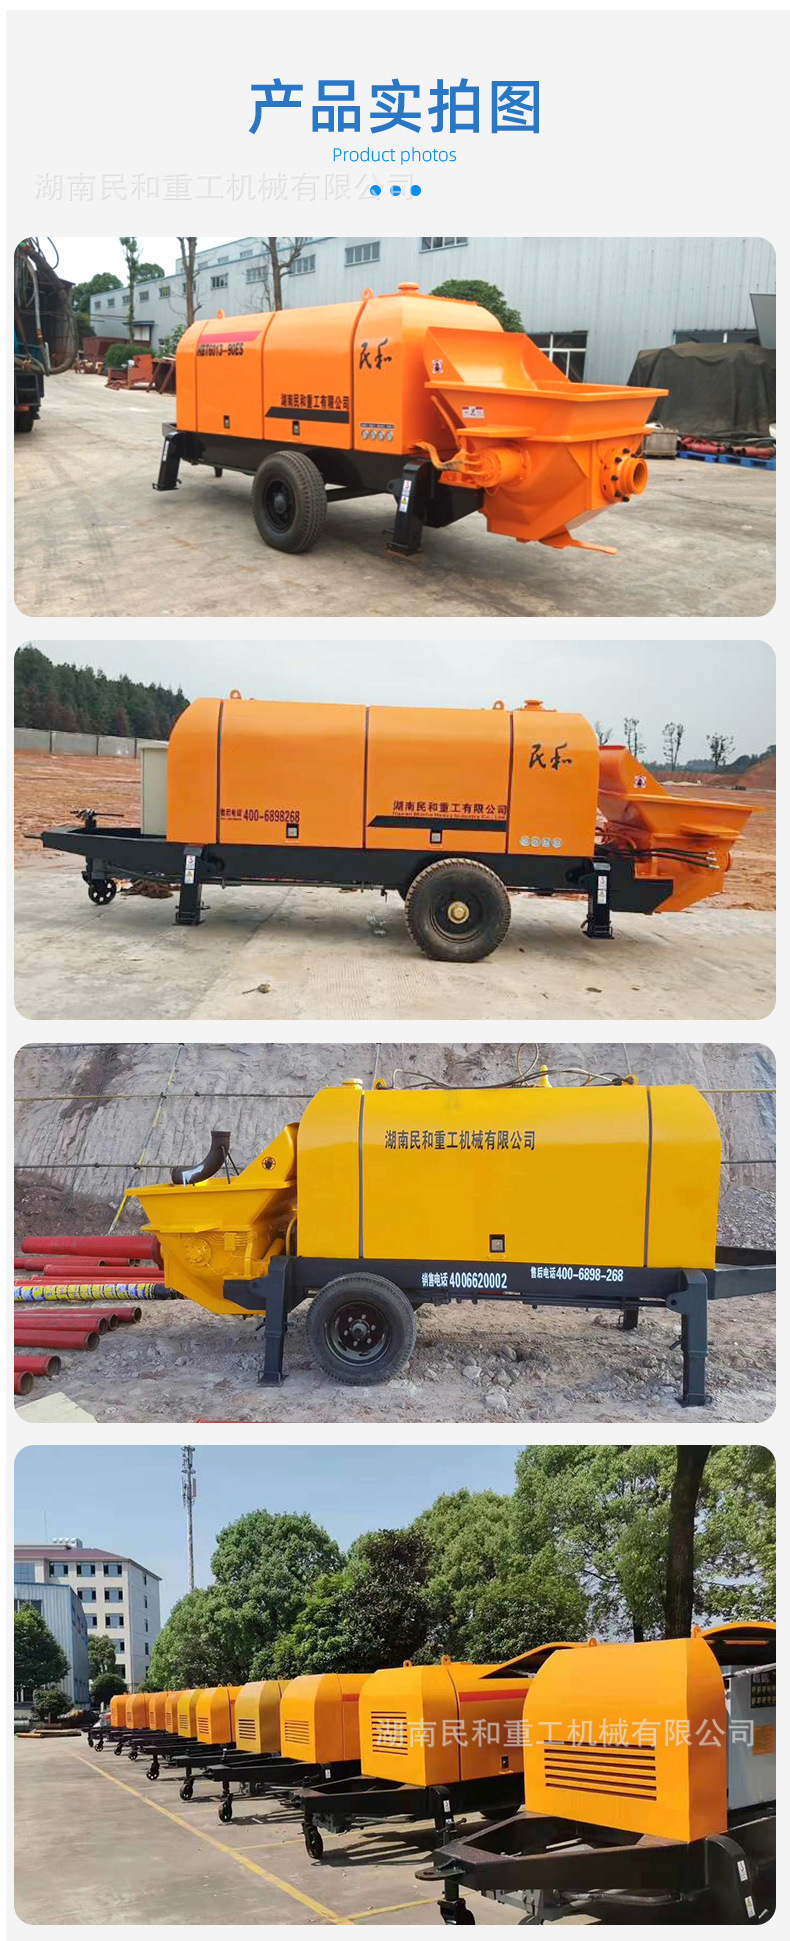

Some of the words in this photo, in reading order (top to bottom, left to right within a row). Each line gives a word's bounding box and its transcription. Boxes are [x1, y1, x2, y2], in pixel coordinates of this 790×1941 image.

[359, 338, 392, 369] 民和
[280, 393, 350, 411] 湖南民和重工有限公司
[529, 742, 572, 770] 民和
[243, 809, 300, 822] 400-6898268
[393, 800, 508, 815] 湖南民和重工有限公司
[384, 1130, 536, 1151] 湖南民和重工机械有限公司
[449, 1272, 508, 1289] 4006620002
